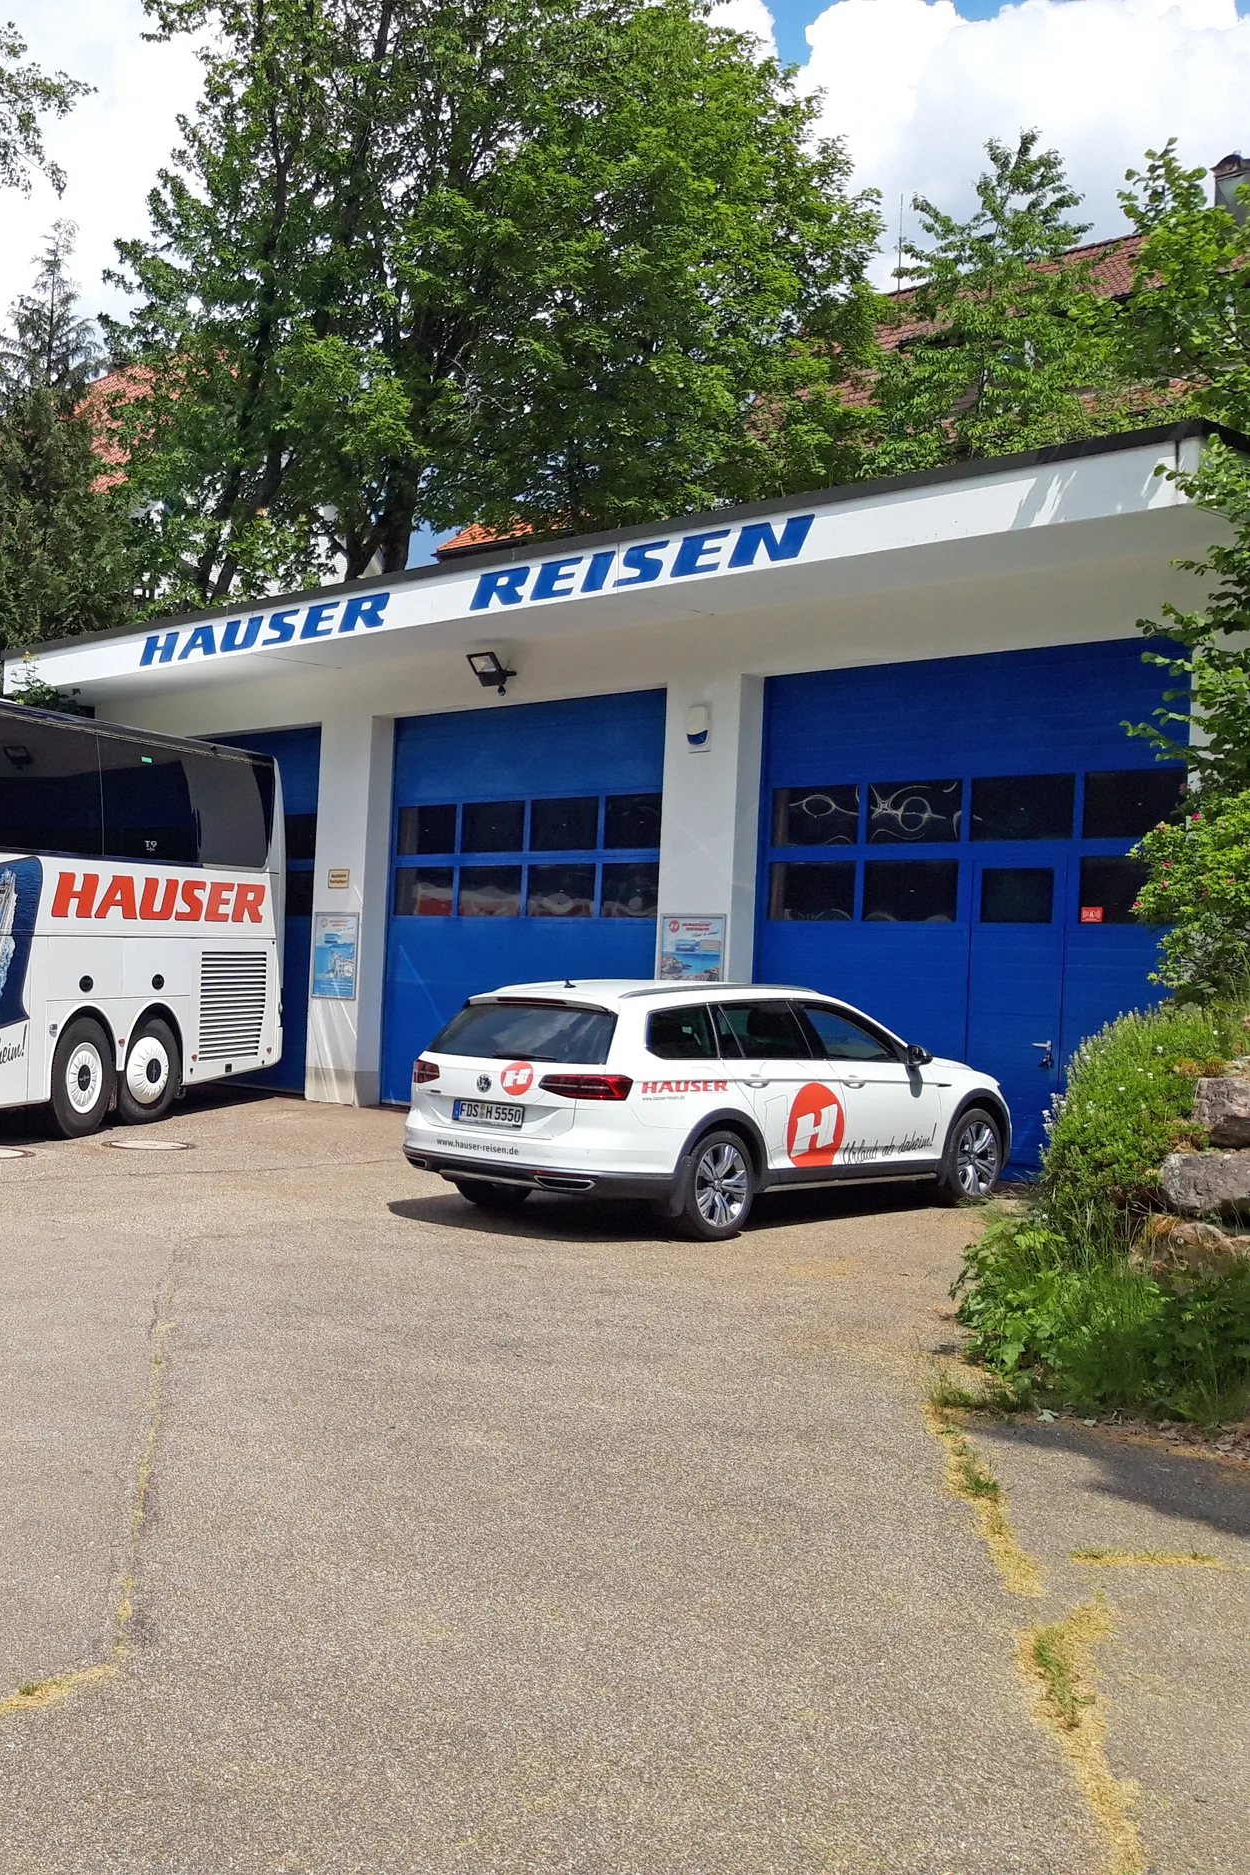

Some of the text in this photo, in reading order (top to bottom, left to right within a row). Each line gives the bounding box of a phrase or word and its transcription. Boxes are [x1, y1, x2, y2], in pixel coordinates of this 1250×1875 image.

[139, 513, 815, 668] HAUSER REISEN
[51, 871, 266, 923] HAUSER
[641, 1080, 729, 1094] HAUSER
[460, 1102, 478, 1118] FDS
[436, 1137, 520, 1157] www.hauser-reisen.de
[843, 1122, 938, 1165] Urlaub ab daheim!
